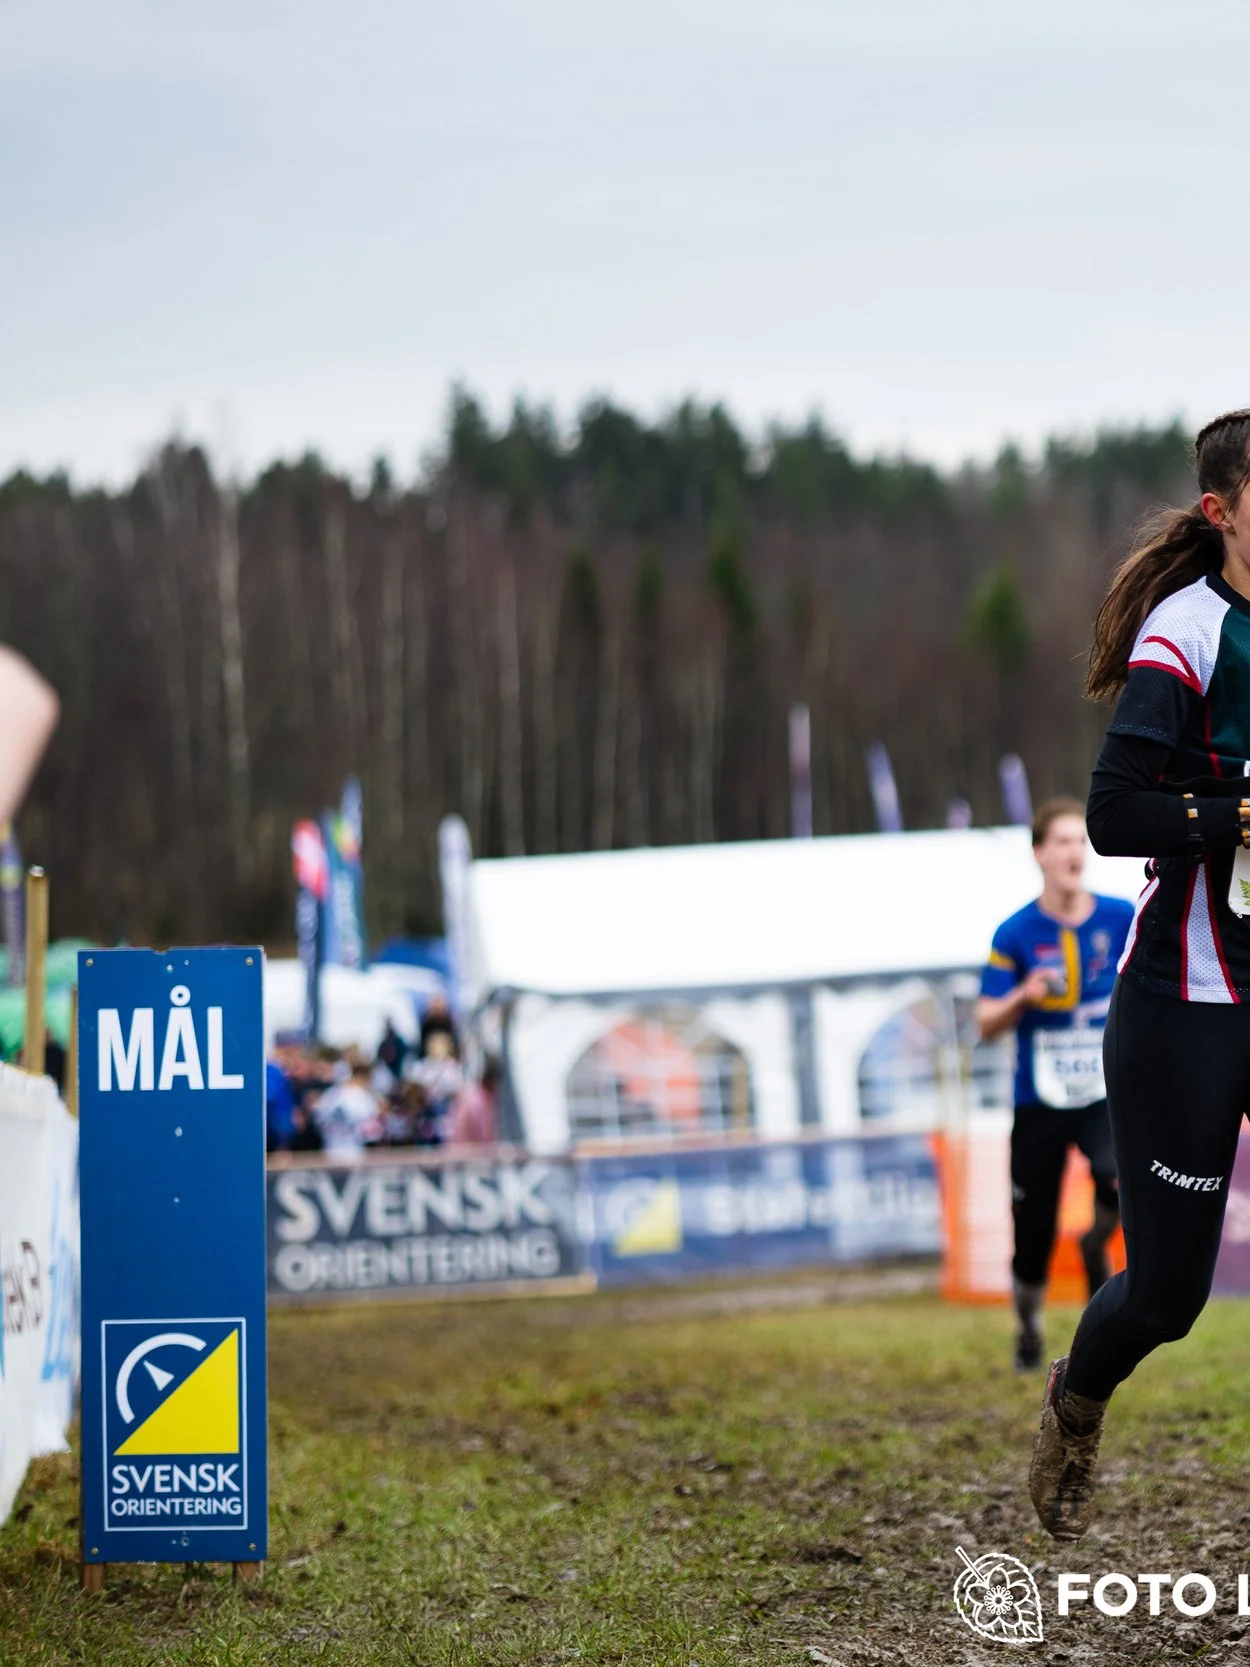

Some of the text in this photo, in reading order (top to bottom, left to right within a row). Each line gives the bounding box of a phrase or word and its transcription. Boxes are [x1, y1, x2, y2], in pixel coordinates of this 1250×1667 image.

[98, 985, 244, 1091] MÅL
[1150, 1160, 1224, 1191] TRIMTEX
[275, 1167, 552, 1242] SVENSK
[274, 1229, 561, 1292] ORIENTERING
[111, 1463, 241, 1494] SVENSK
[111, 1497, 242, 1516] ORIENTERING
